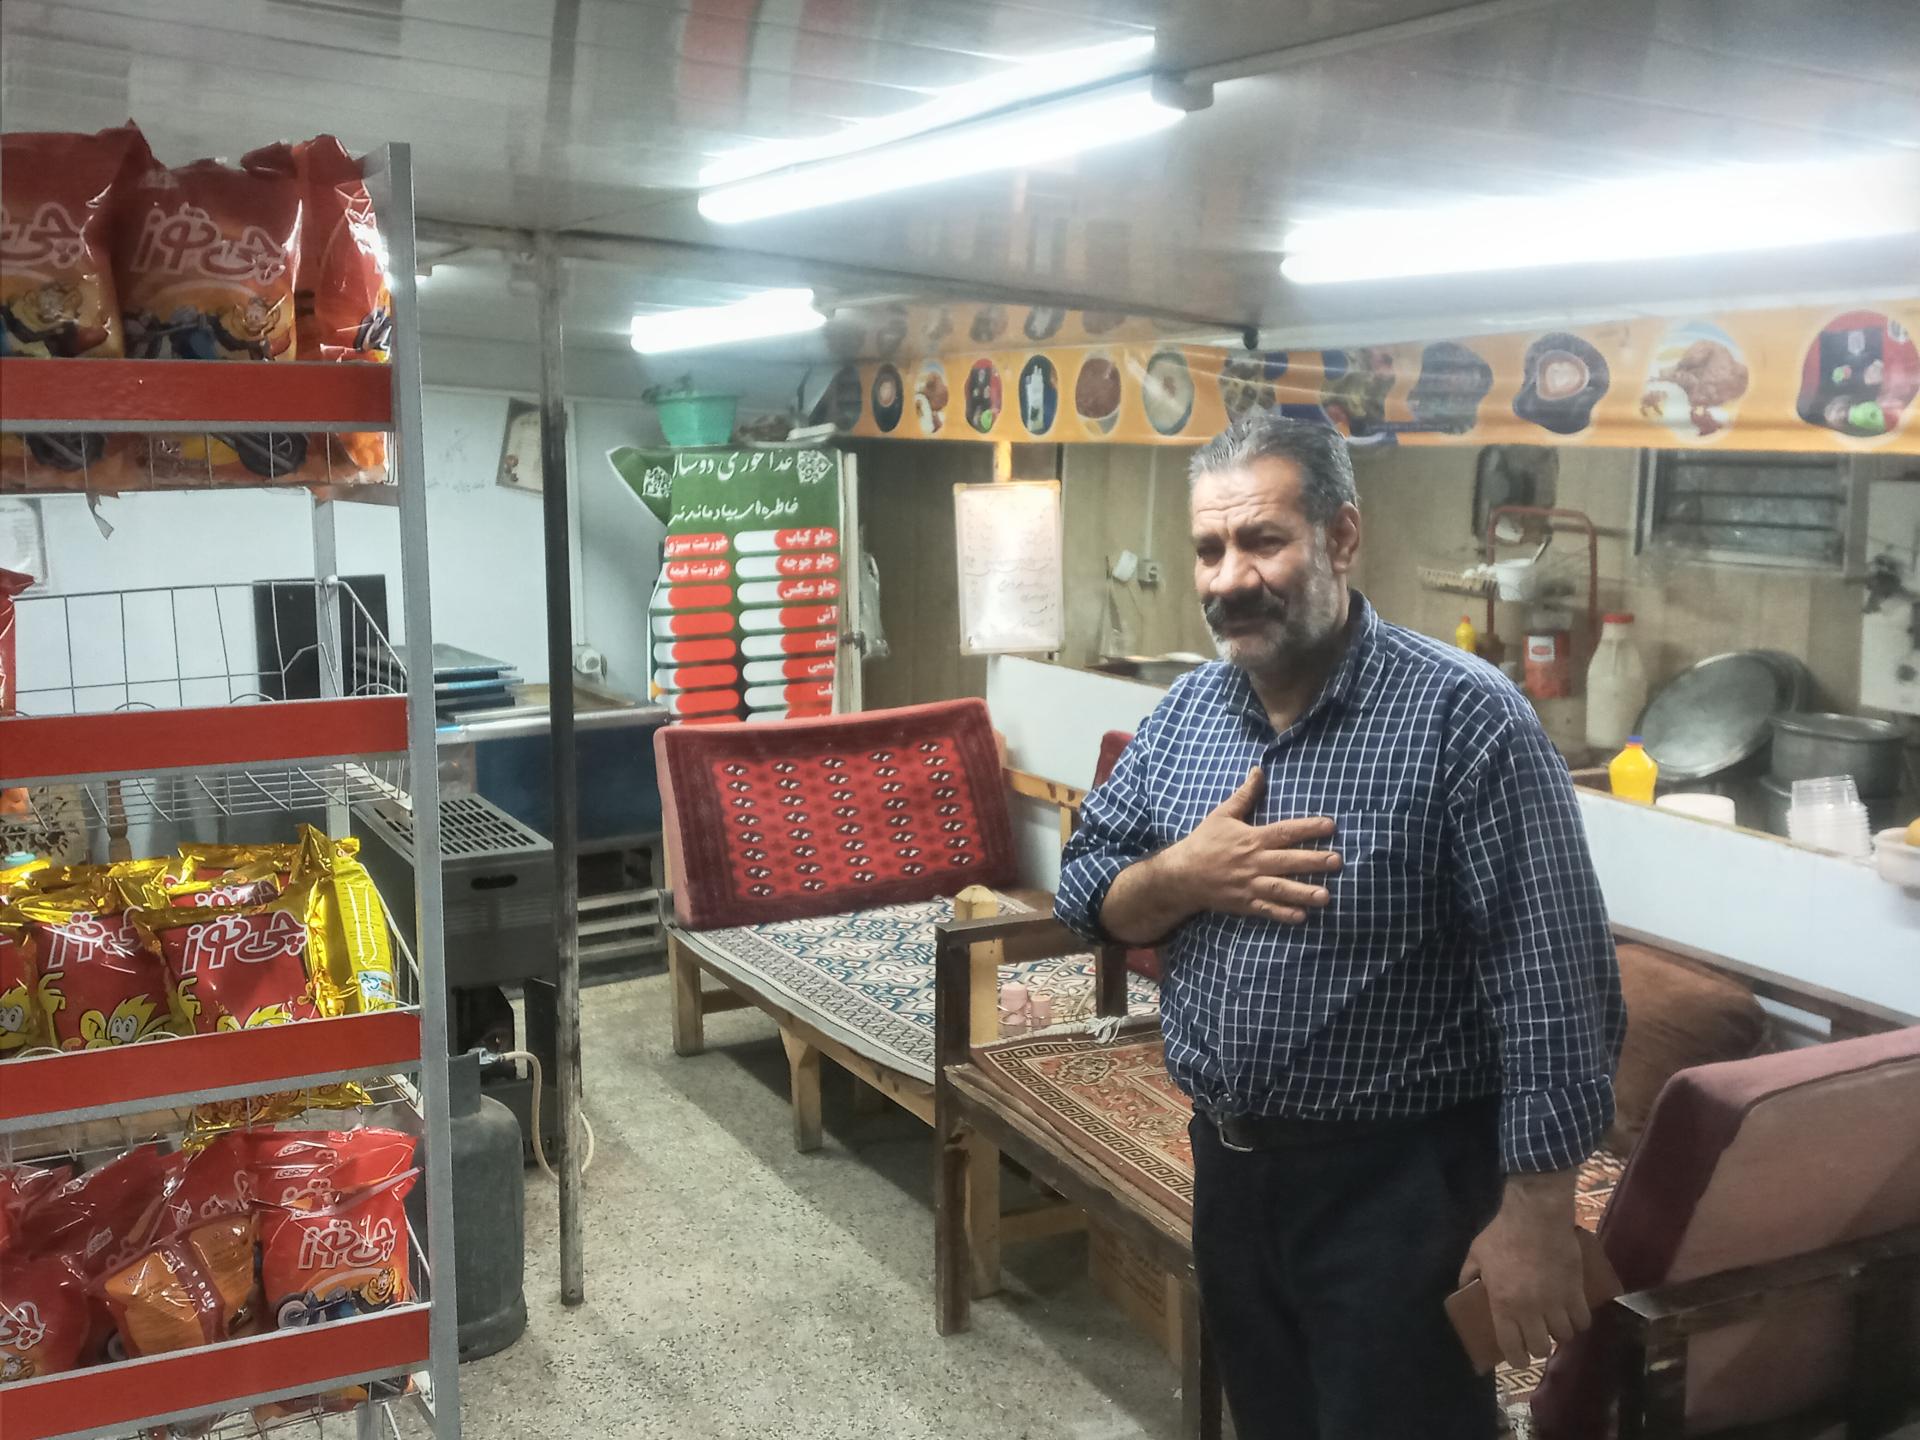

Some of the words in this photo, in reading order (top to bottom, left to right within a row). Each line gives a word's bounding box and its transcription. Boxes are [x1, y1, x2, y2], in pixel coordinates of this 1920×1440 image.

[692, 536, 729, 551] خورشت
[785, 530, 811, 546] کباب
[814, 529, 833, 545] چلو
[690, 561, 726, 576] خورشت
[782, 557, 812, 571] جوجه
[816, 553, 834, 569] چلو
[782, 581, 815, 597] میکس
[817, 580, 836, 596] چلو
[817, 605, 837, 624] آش
